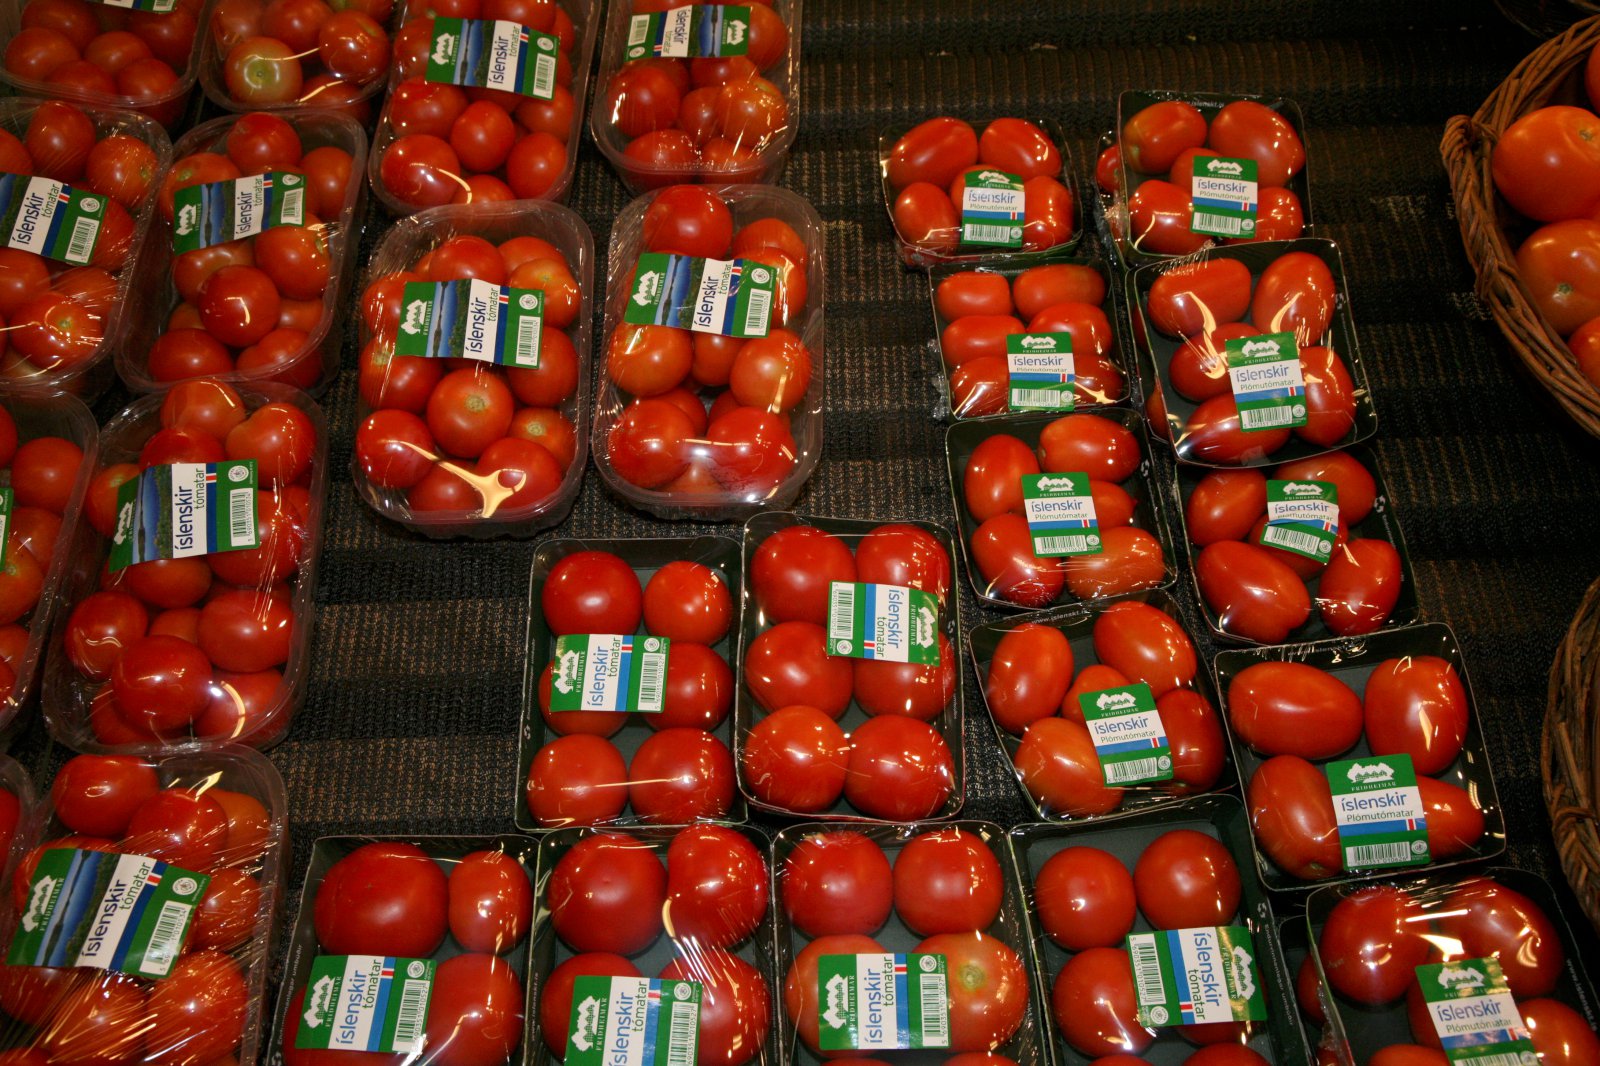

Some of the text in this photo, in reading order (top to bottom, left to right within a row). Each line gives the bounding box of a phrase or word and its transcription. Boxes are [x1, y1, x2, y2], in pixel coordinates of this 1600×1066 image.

[490, 36, 508, 84] íslenskir
[508, 26, 519, 57] tómatar
[41, 183, 60, 219] tómatar
[1198, 179, 1246, 194] íslenskir
[1200, 190, 1249, 201] Plómutómatar
[16, 192, 44, 245] íslenskir
[236, 192, 252, 234] íslenskir
[718, 264, 732, 295] tómatar
[487, 288, 499, 321] tómatar
[694, 276, 719, 327] íslenskir
[465, 297, 487, 353] íslenskir
[1014, 354, 1063, 367] íslenskir
[1236, 364, 1289, 382] íslenskir
[1240, 378, 1294, 392] Plómutómatar
[195, 469, 204, 509] tómatar
[1031, 500, 1083, 513] íslenskir
[175, 486, 192, 550] íslenskir
[1035, 512, 1087, 522] Plómutómatar
[876, 616, 884, 657] tómatar
[888, 589, 902, 648] íslenskir
[587, 645, 609, 706] íslenskir
[608, 637, 619, 677] tómatar
[1094, 715, 1149, 735] íslenskir
[1100, 729, 1156, 744] Plómutómatar
[1341, 793, 1407, 811] íslenskir
[1346, 809, 1414, 823] Plómutómatar
[120, 862, 151, 910] tómatar
[81, 880, 128, 957] íslenskir
[363, 959, 382, 1009] tómatar
[883, 956, 893, 1006] tómatar
[1193, 932, 1219, 1006] íslenskir
[336, 970, 367, 1044] íslenskir
[632, 981, 649, 1032] tómatar
[864, 968, 882, 1043] íslenskir
[1190, 968, 1205, 1019] tómatar
[1437, 999, 1501, 1022] íslenskir
